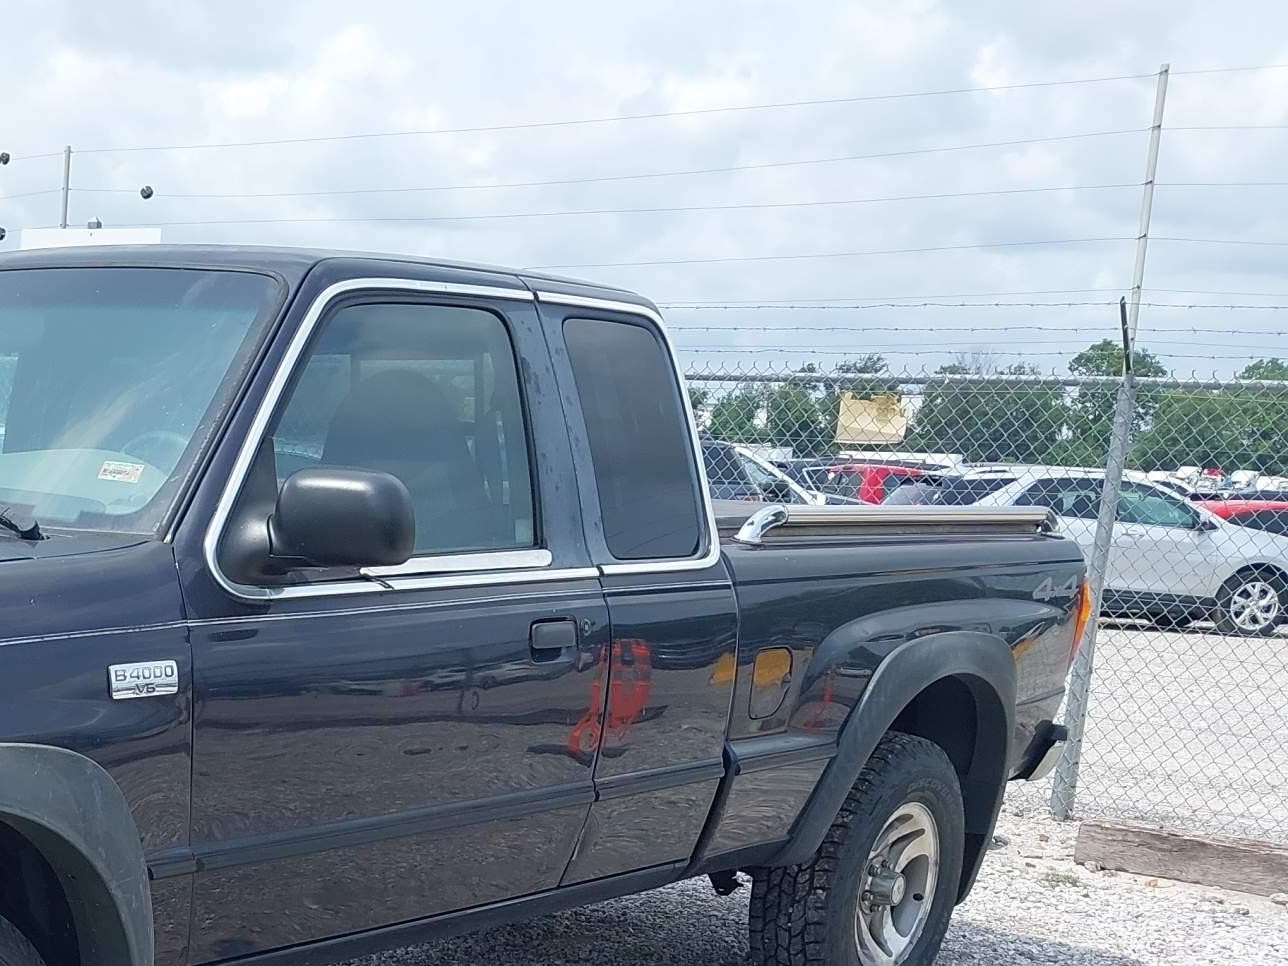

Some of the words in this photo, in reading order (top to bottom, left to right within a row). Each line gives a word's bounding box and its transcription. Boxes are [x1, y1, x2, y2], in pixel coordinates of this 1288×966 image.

[1032, 574, 1079, 602] 4x4
[114, 664, 175, 682] B4000
[134, 682, 157, 696] V6
